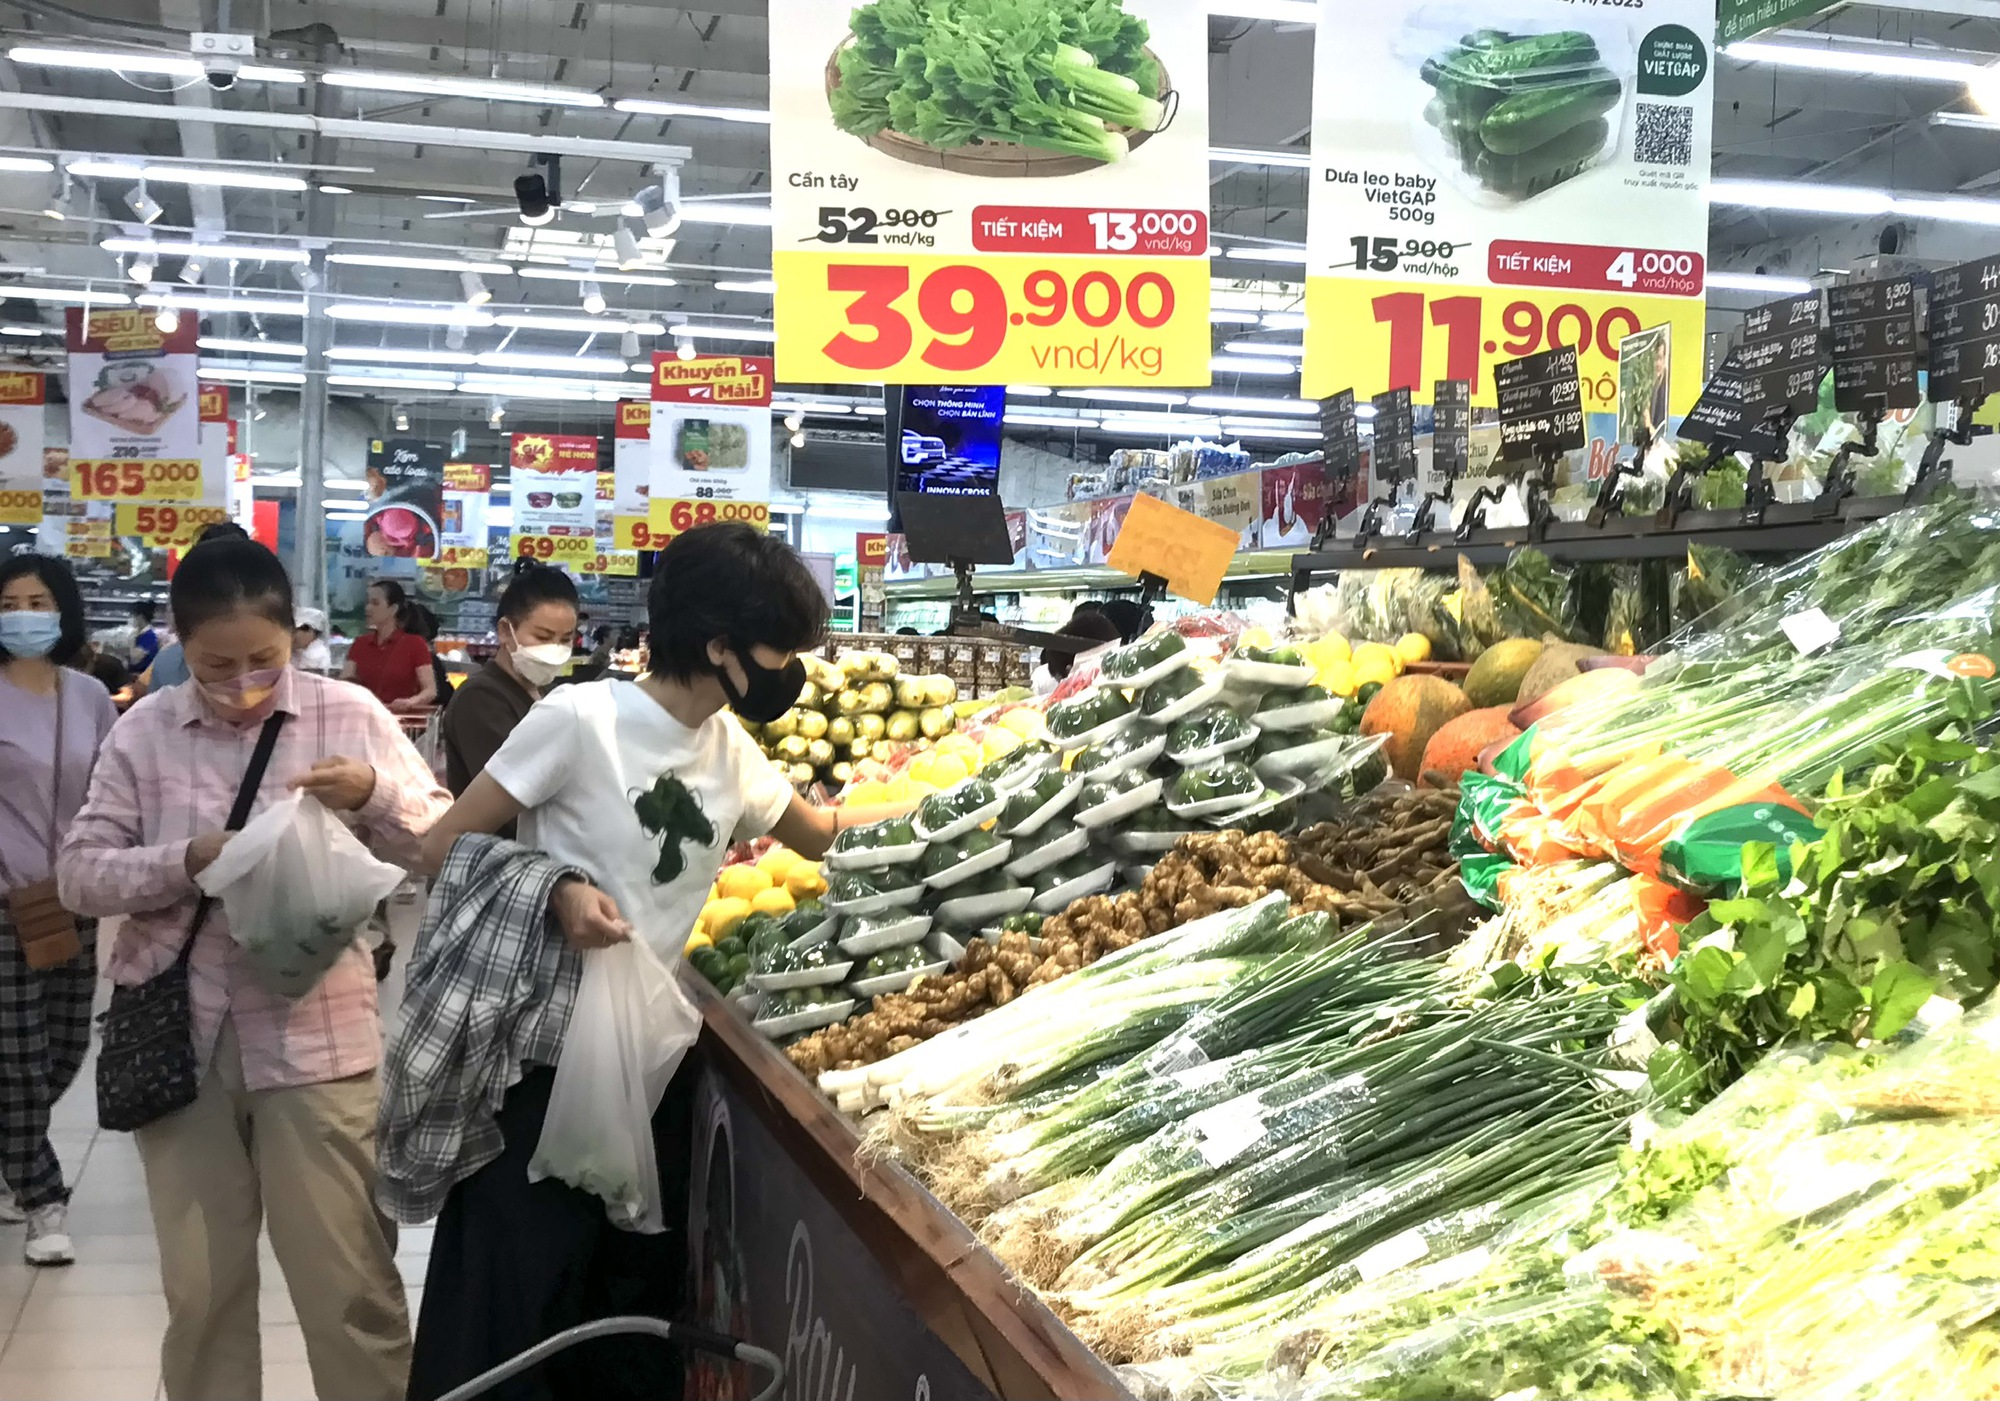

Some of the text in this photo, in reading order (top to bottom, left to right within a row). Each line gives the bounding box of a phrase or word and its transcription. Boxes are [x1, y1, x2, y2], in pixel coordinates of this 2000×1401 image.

[1644, 59, 1701, 78] VIETGAP
[830, 174, 859, 192] tây
[1325, 168, 1437, 192] Dưa leo baby
[1364, 188, 1436, 206] VietGAP
[1389, 206, 1435, 226] 500g
[883, 231, 935, 247] vnd/kg
[981, 216, 1063, 241] TIẾT KIỆM
[1087, 212, 1197, 251] 13.000
[1144, 236, 1192, 253] vnd/kg
[1402, 261, 1459, 278] vnd/hộp
[1496, 250, 1571, 276] TIẾT KIỆM
[1605, 251, 1693, 288] 4.000
[1642, 276, 1695, 292] vnd/hộp
[821, 263, 1176, 371] 39.900
[1371, 292, 1642, 396] 11.900
[1031, 335, 1163, 376] vnd/kg
[663, 361, 737, 381] Khuyến
[74, 462, 200, 497] 165.000
[517, 536, 589, 558] 69.000
